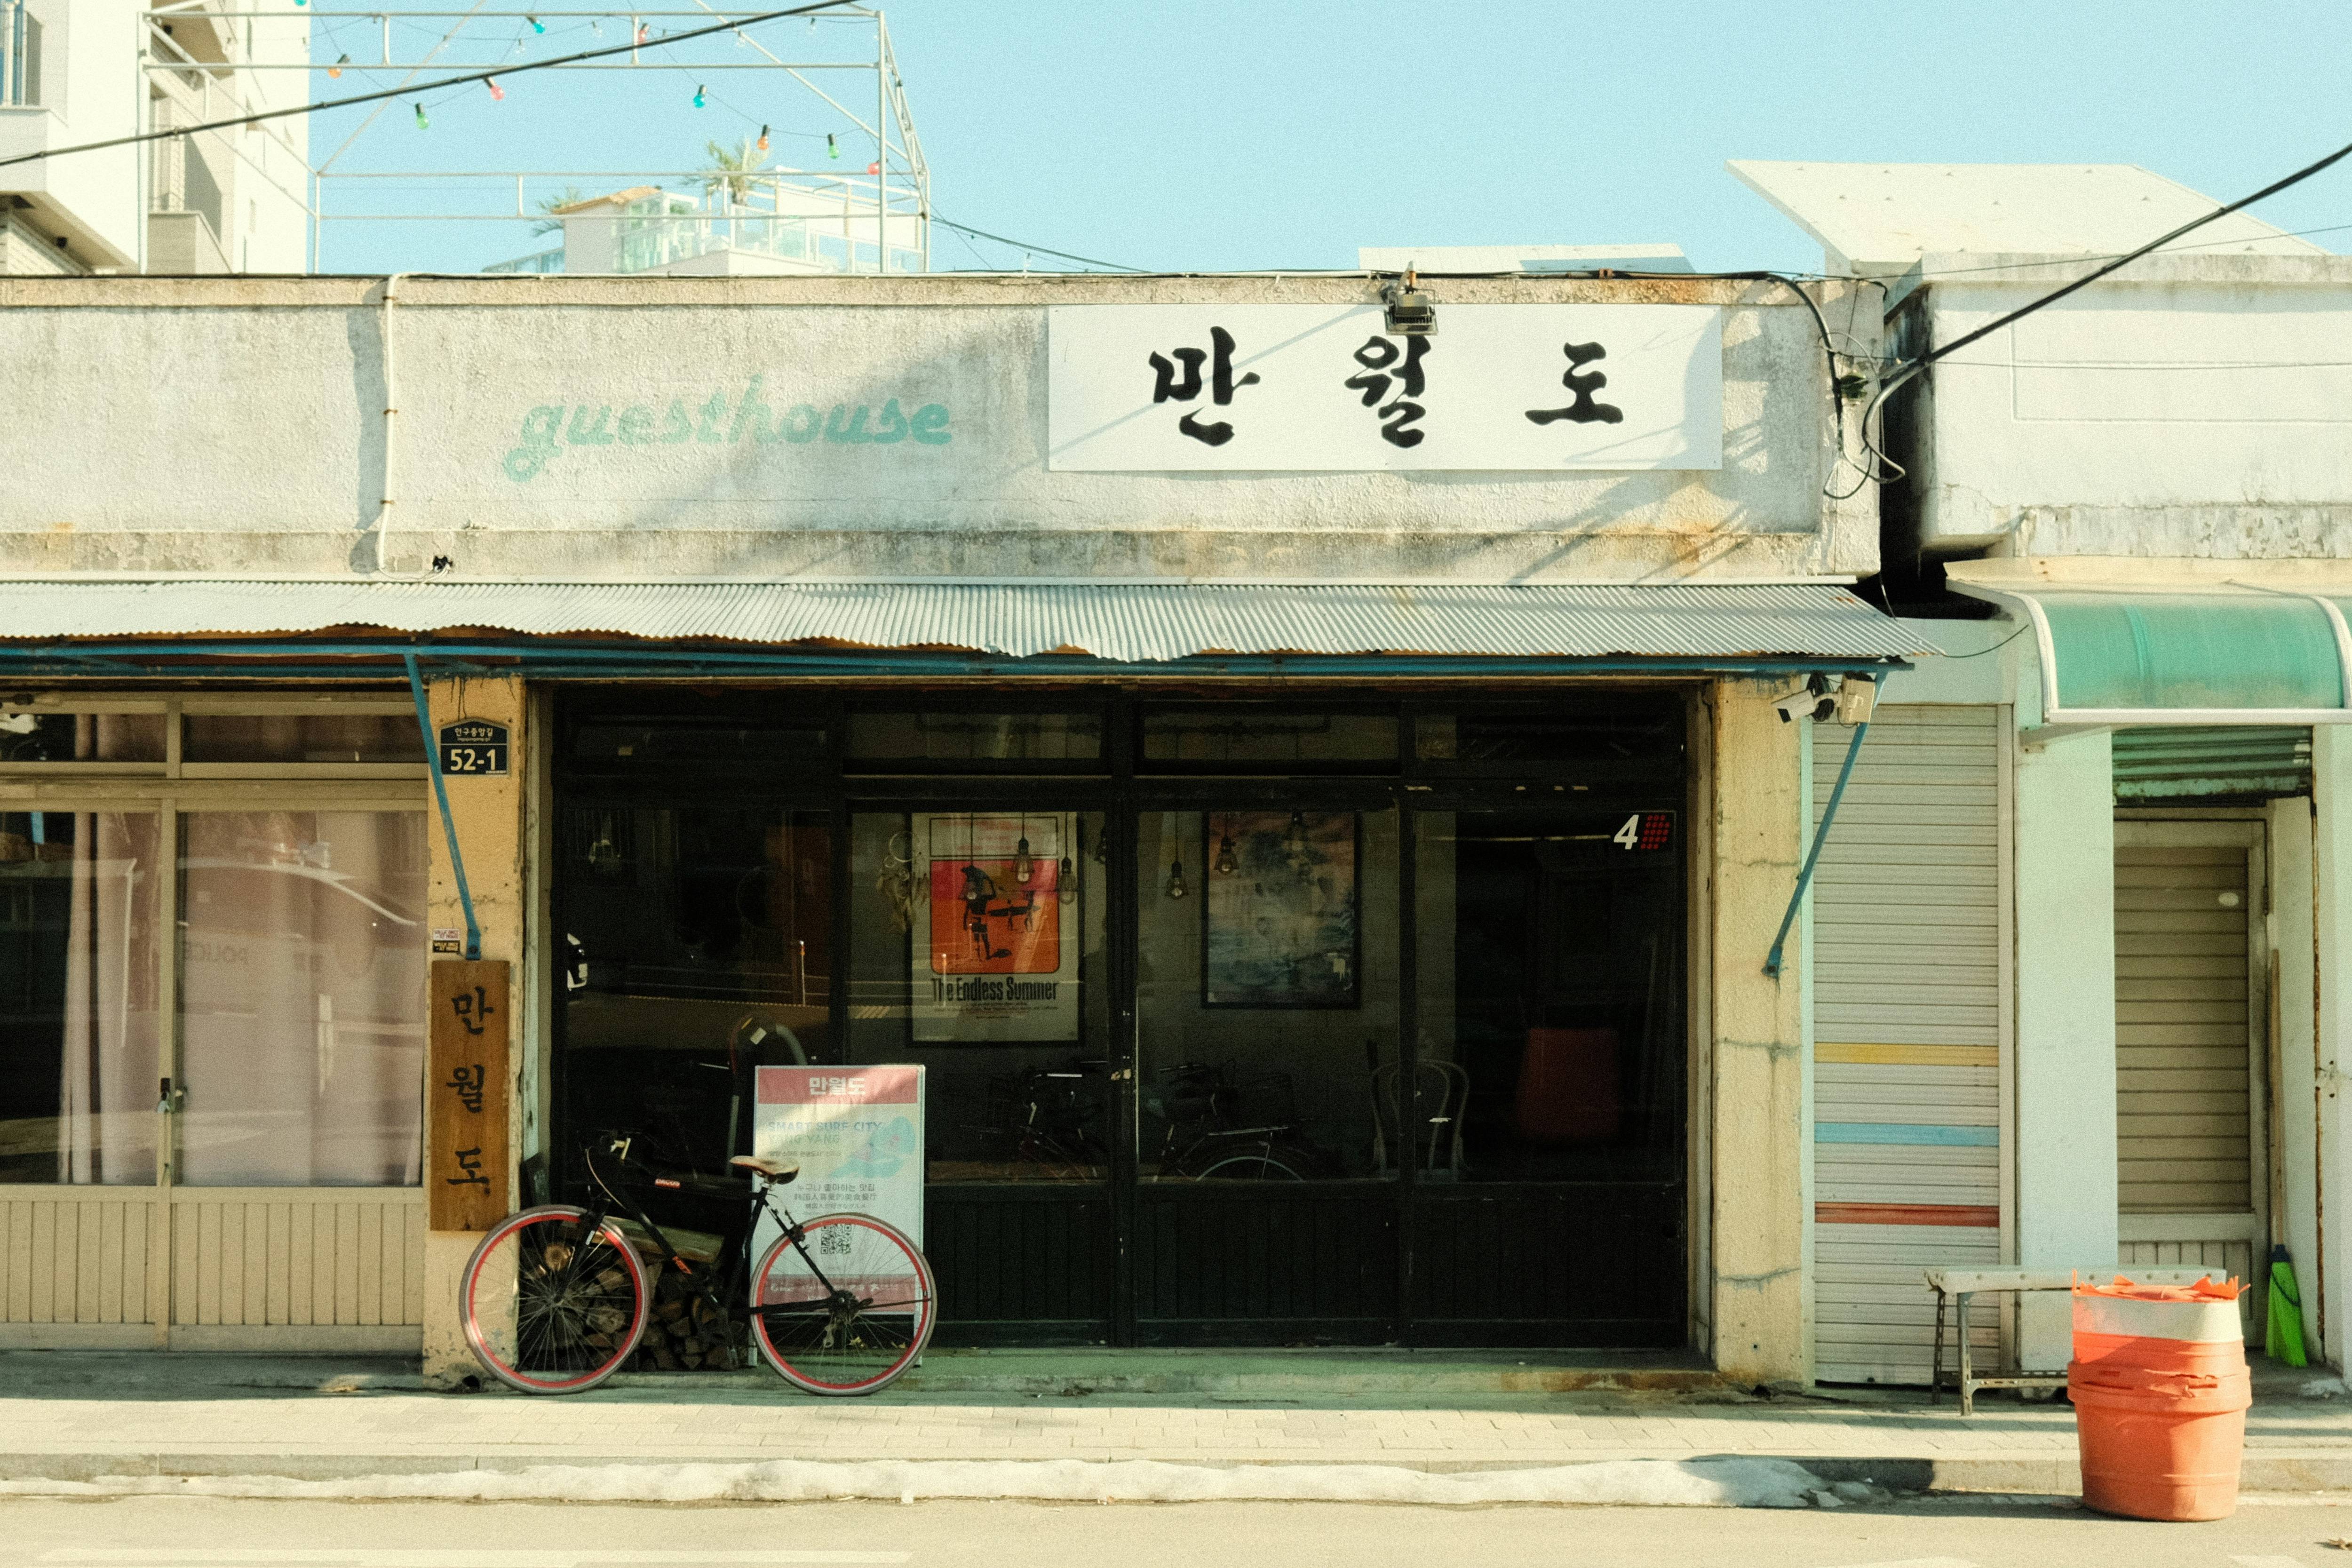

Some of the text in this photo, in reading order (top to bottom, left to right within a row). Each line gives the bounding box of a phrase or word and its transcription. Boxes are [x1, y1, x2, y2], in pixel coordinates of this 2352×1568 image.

[502, 374, 952, 482] guesthouse
[450, 748, 496, 771] 52-1
[931, 976, 1059, 1002] The Endless Summer
[809, 1076, 866, 1096] 만월도
[816, 1121, 849, 1131] SURF
[853, 1121, 882, 1131] CITY
